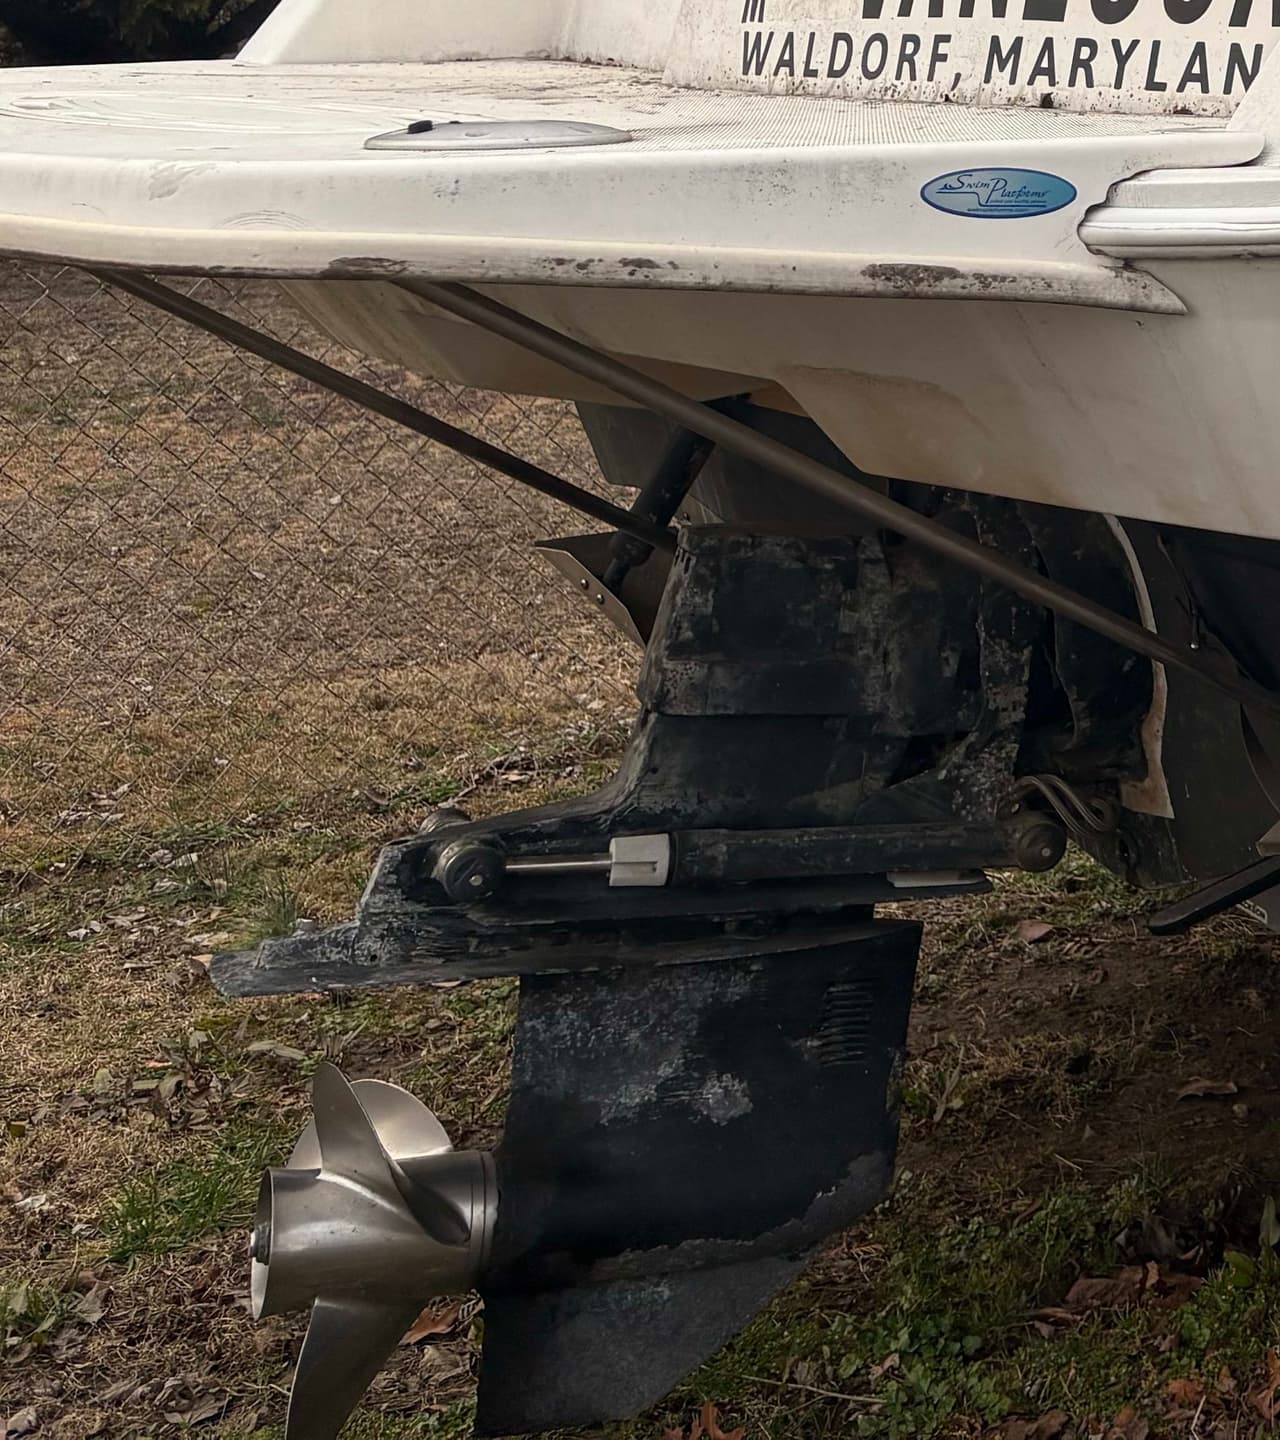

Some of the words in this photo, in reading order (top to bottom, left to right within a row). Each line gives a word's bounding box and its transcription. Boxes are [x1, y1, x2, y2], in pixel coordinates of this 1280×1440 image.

[742, 31, 962, 91] WALDORF,
[984, 36, 1264, 95] MARYLAN
[955, 174, 990, 189] Swim
